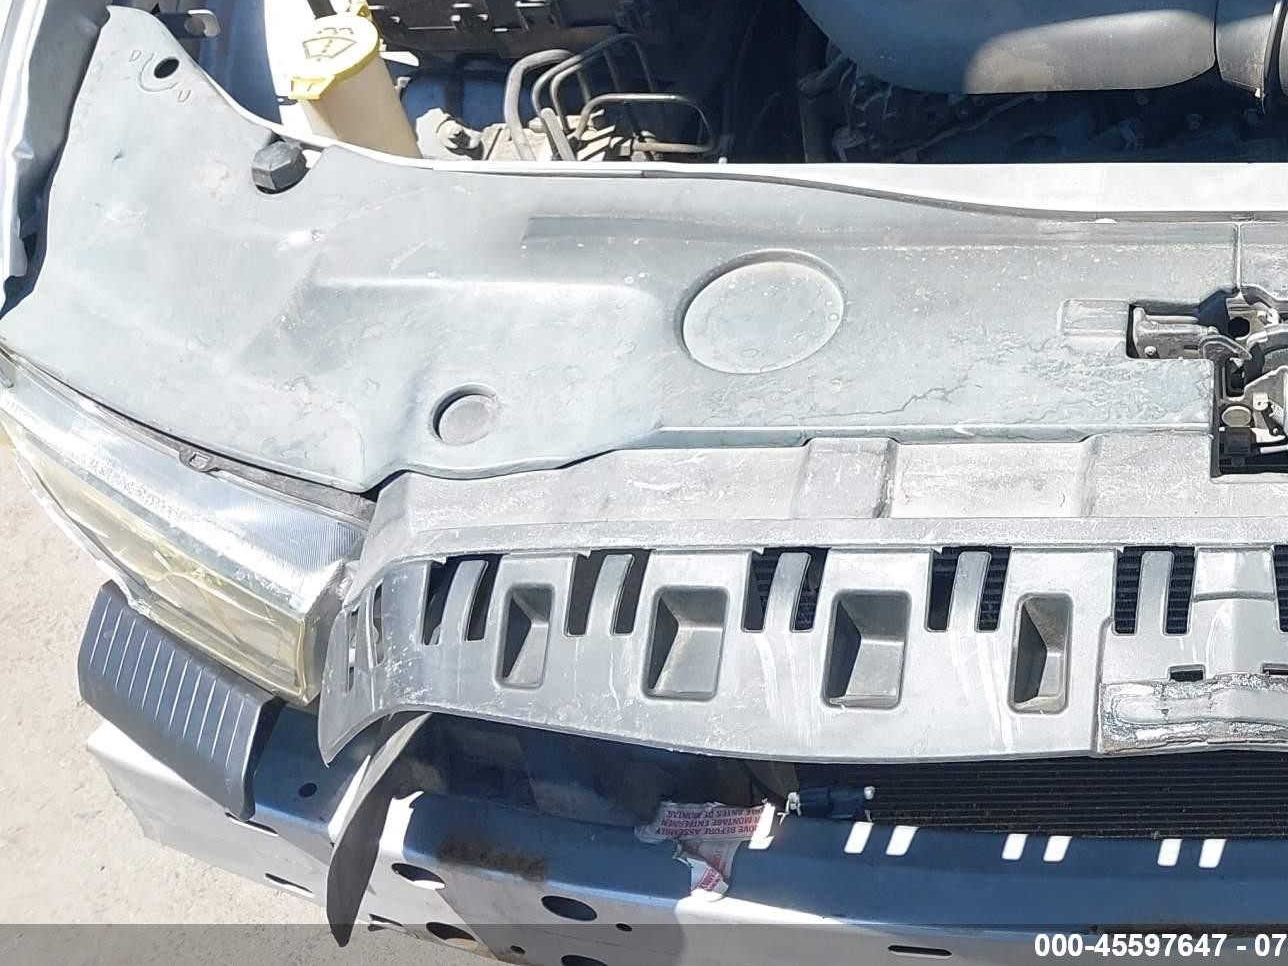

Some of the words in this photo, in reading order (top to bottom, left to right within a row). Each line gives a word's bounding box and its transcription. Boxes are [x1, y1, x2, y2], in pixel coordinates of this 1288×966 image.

[703, 810, 714, 819] DE
[717, 809, 744, 818] ANTES
[711, 817, 751, 826] MONTAGE
[656, 827, 701, 836] ASSEMBLY
[704, 826, 736, 835] BEFORE
